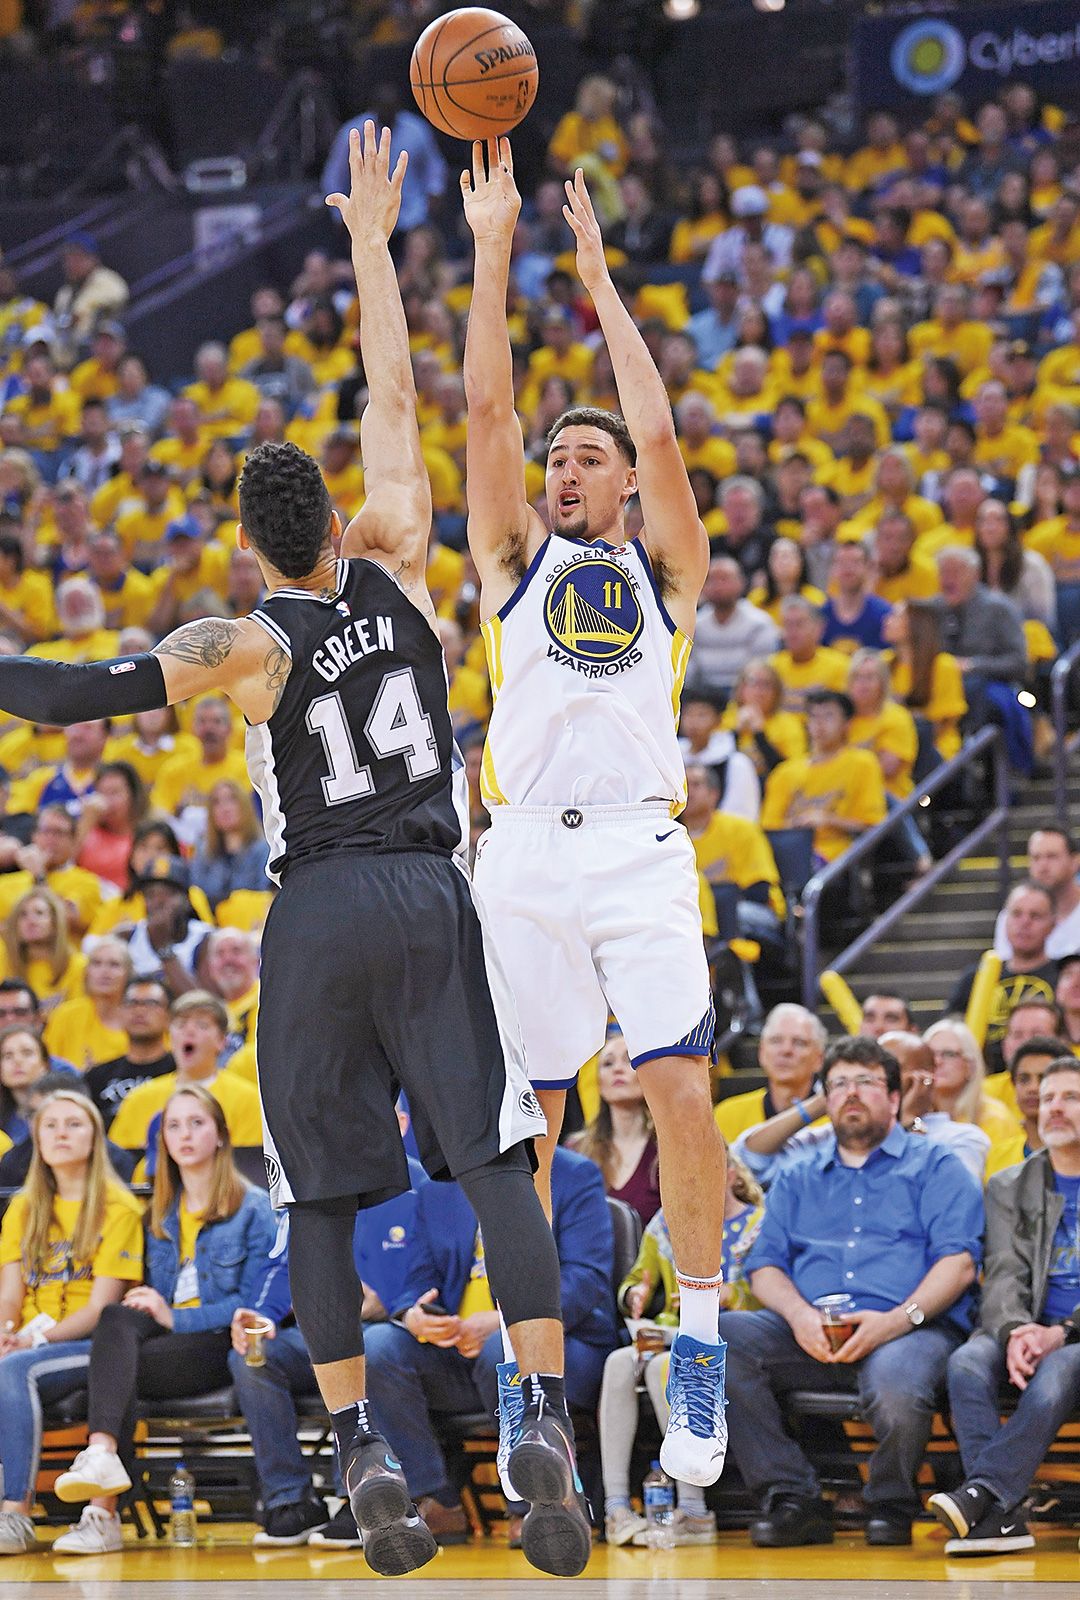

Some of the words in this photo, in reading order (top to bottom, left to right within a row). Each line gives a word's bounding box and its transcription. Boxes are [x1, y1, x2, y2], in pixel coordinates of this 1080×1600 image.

[545, 549, 604, 583] GOLDEN
[609, 555, 641, 593] STATE
[602, 581, 622, 608] 11
[312, 616, 395, 682] GREEN
[546, 644, 643, 679] WARRIORS
[304, 666, 441, 807] 14
